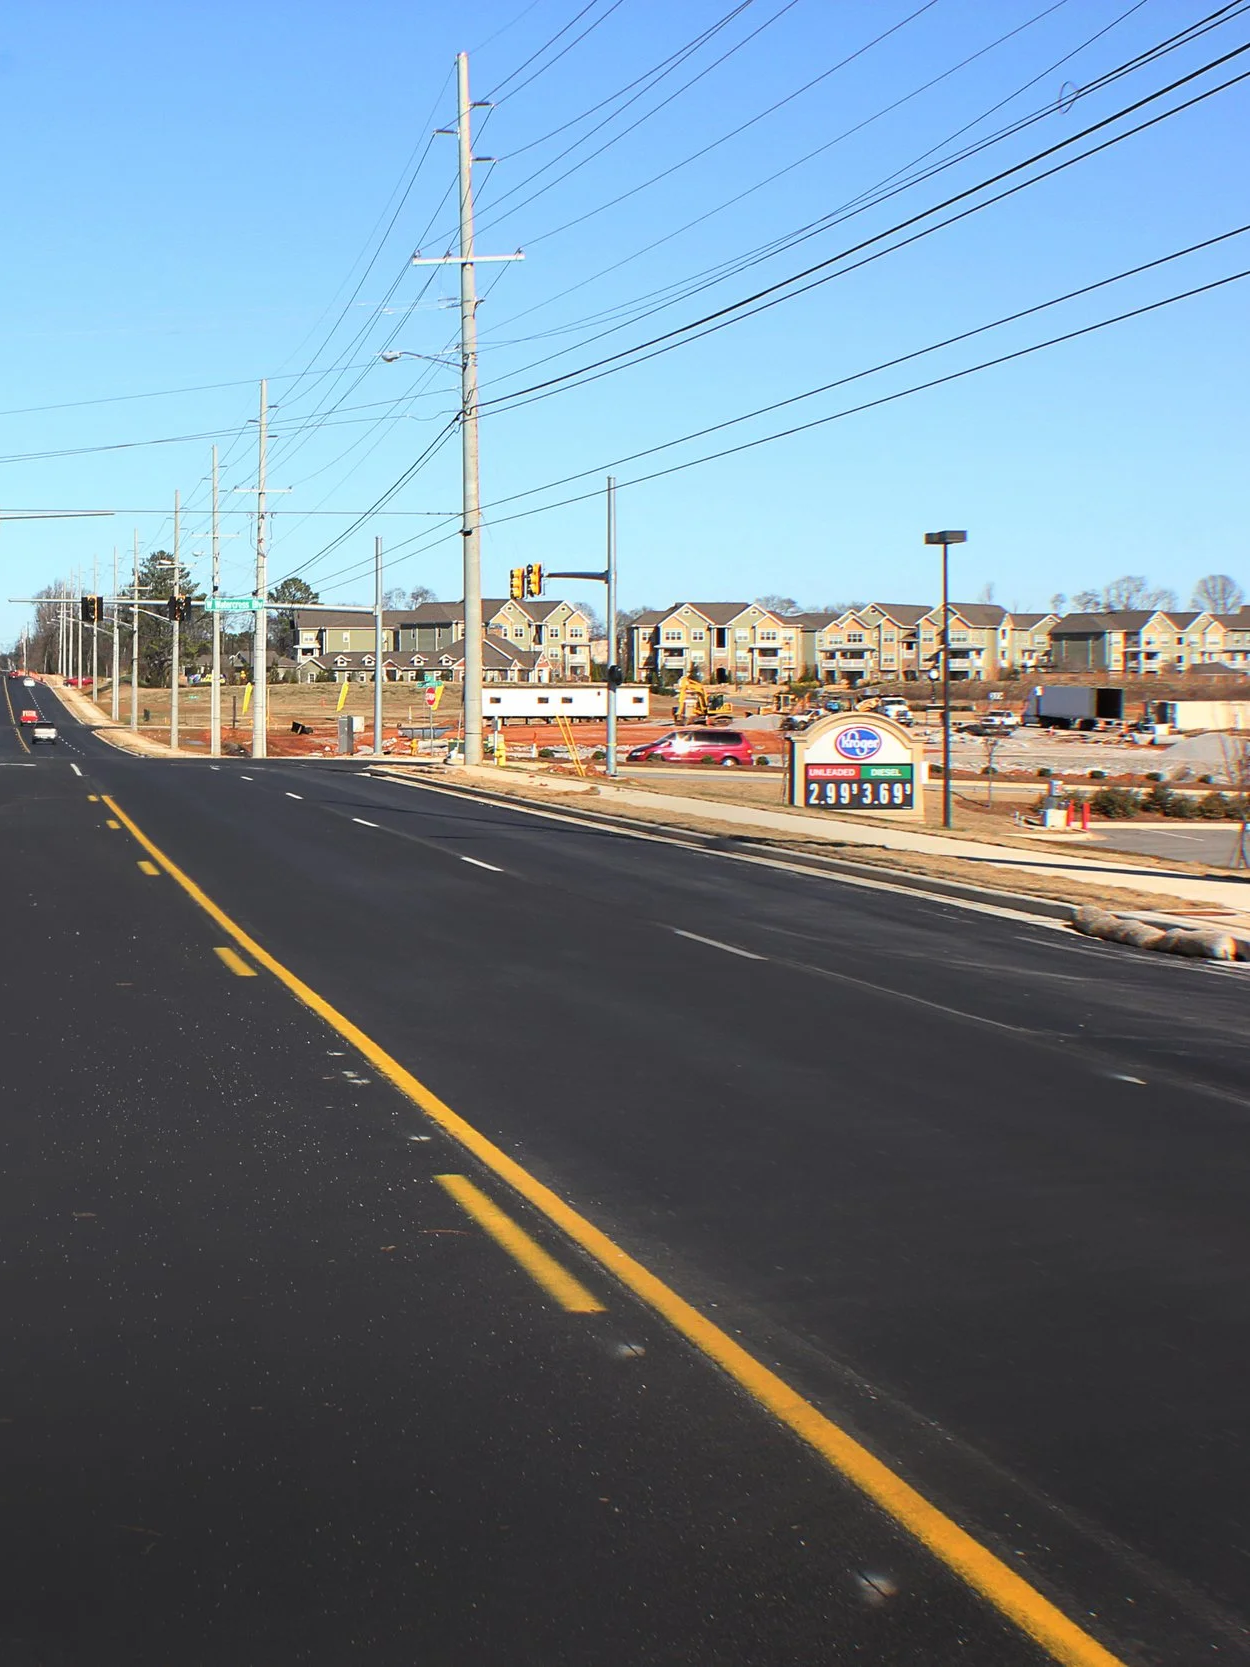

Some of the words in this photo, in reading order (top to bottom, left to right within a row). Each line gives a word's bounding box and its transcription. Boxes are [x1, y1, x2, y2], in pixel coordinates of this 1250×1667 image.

[215, 600, 250, 609] Watercress
[809, 768, 855, 777] UNLEADED
[870, 768, 902, 777] DIESEL
